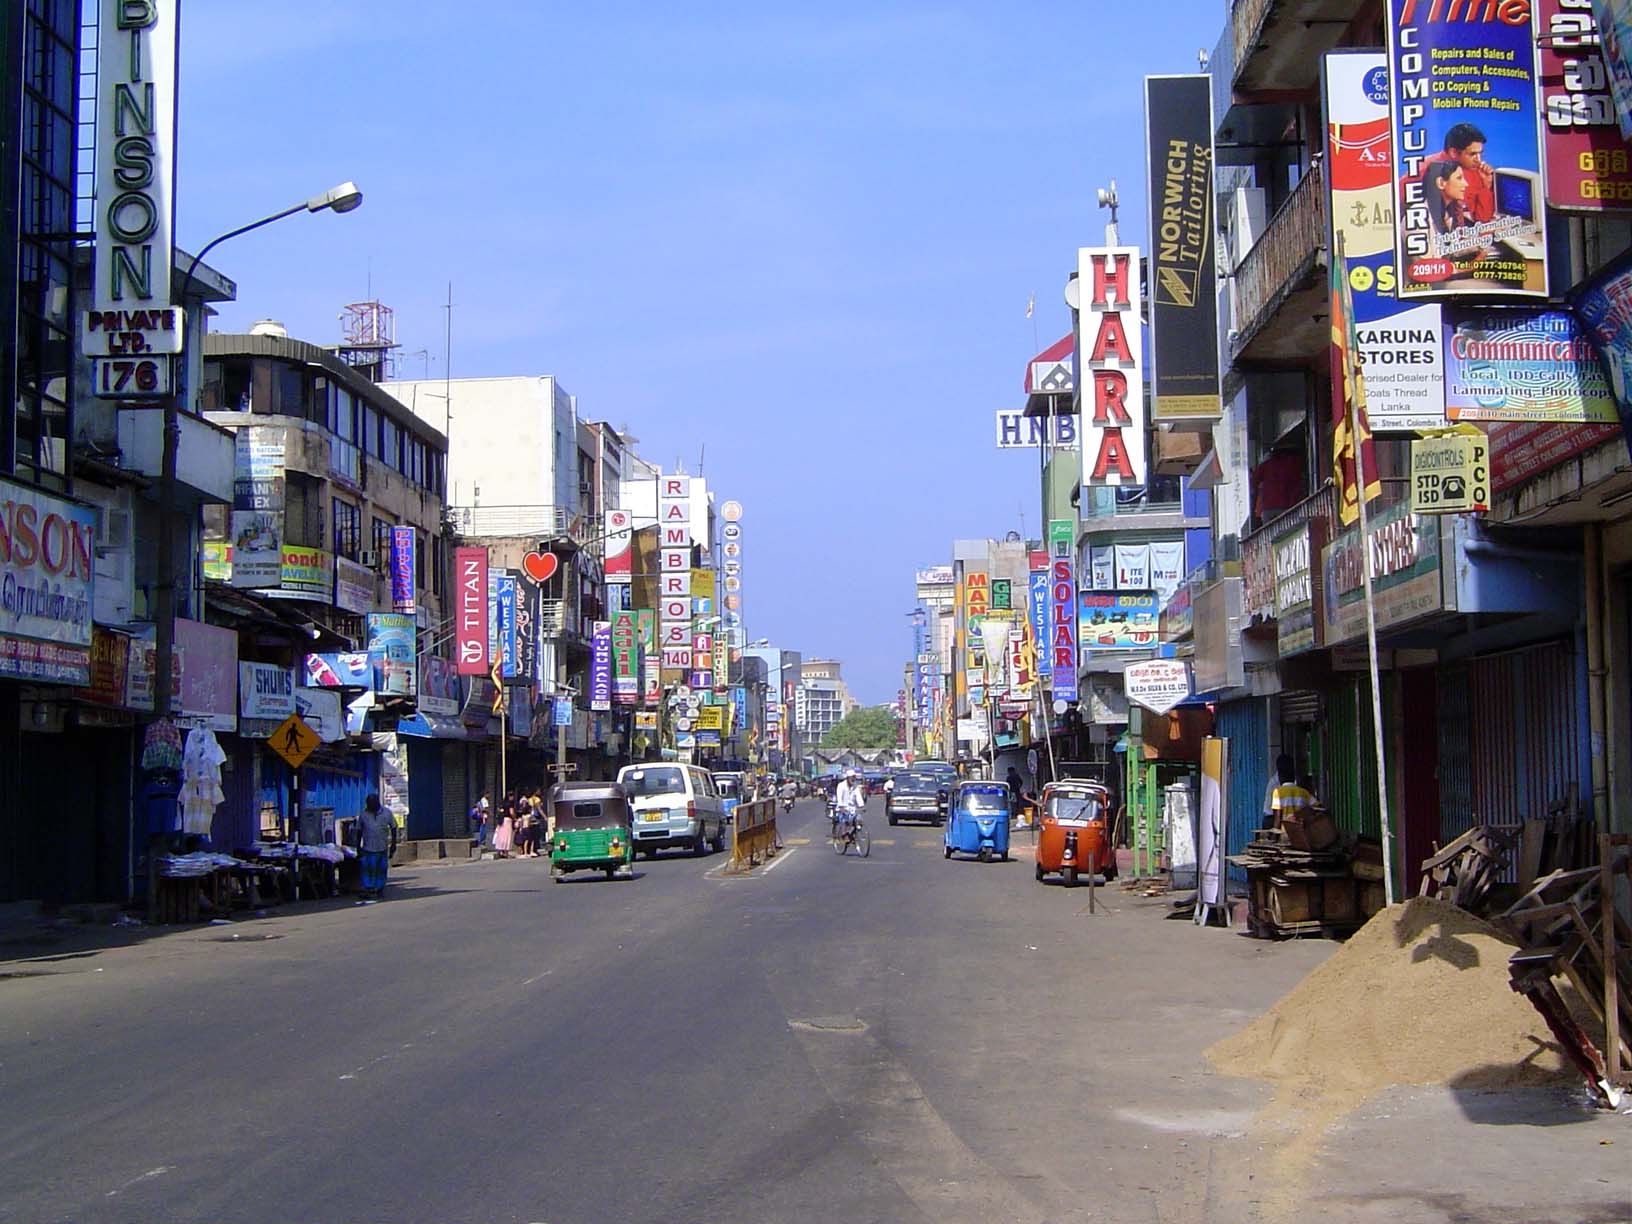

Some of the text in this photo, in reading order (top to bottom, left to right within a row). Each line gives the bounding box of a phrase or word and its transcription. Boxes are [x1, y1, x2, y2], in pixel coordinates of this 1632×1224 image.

[1431, 48, 1515, 61] Repairs and Sales of
[1431, 65, 1481, 77] Computers,
[1432, 81, 1490, 94] CD Copying &
[1432, 97, 1520, 111] Mobile Phone Repairs
[1400, 28, 1429, 255] COMPUTERS
[1159, 139, 1189, 262] NORWICH
[1179, 143, 1214, 262] Tailoring
[1413, 263, 1446, 276] 209/1/1
[88, 309, 176, 331] PRIVATE
[108, 332, 152, 354] LTD.
[102, 360, 159, 392] 176
[1089, 254, 1134, 483] HARA
[1396, 373, 1428, 382] Dealer
[1394, 388, 1427, 397] Thread
[1380, 402, 1411, 412] Lanka
[1000, 413, 1076, 445] HNB
[1415, 450, 1464, 470] DIGICONTROLS
[1417, 475, 1440, 489] STD
[1473, 446, 1486, 503] PCO
[1418, 490, 1440, 504] ISD
[609, 529, 629, 539] LG
[666, 480, 685, 641] RAMBROS
[464, 561, 480, 631] TITAN
[1054, 562, 1073, 667] SOLAR
[502, 596, 511, 663] WESTAR
[1034, 592, 1045, 661] WESTAR
[614, 614, 634, 676] Aadil
[337, 653, 368, 664] PEPSI
[664, 651, 690, 666] 140
[920, 664, 929, 726] GANESH
